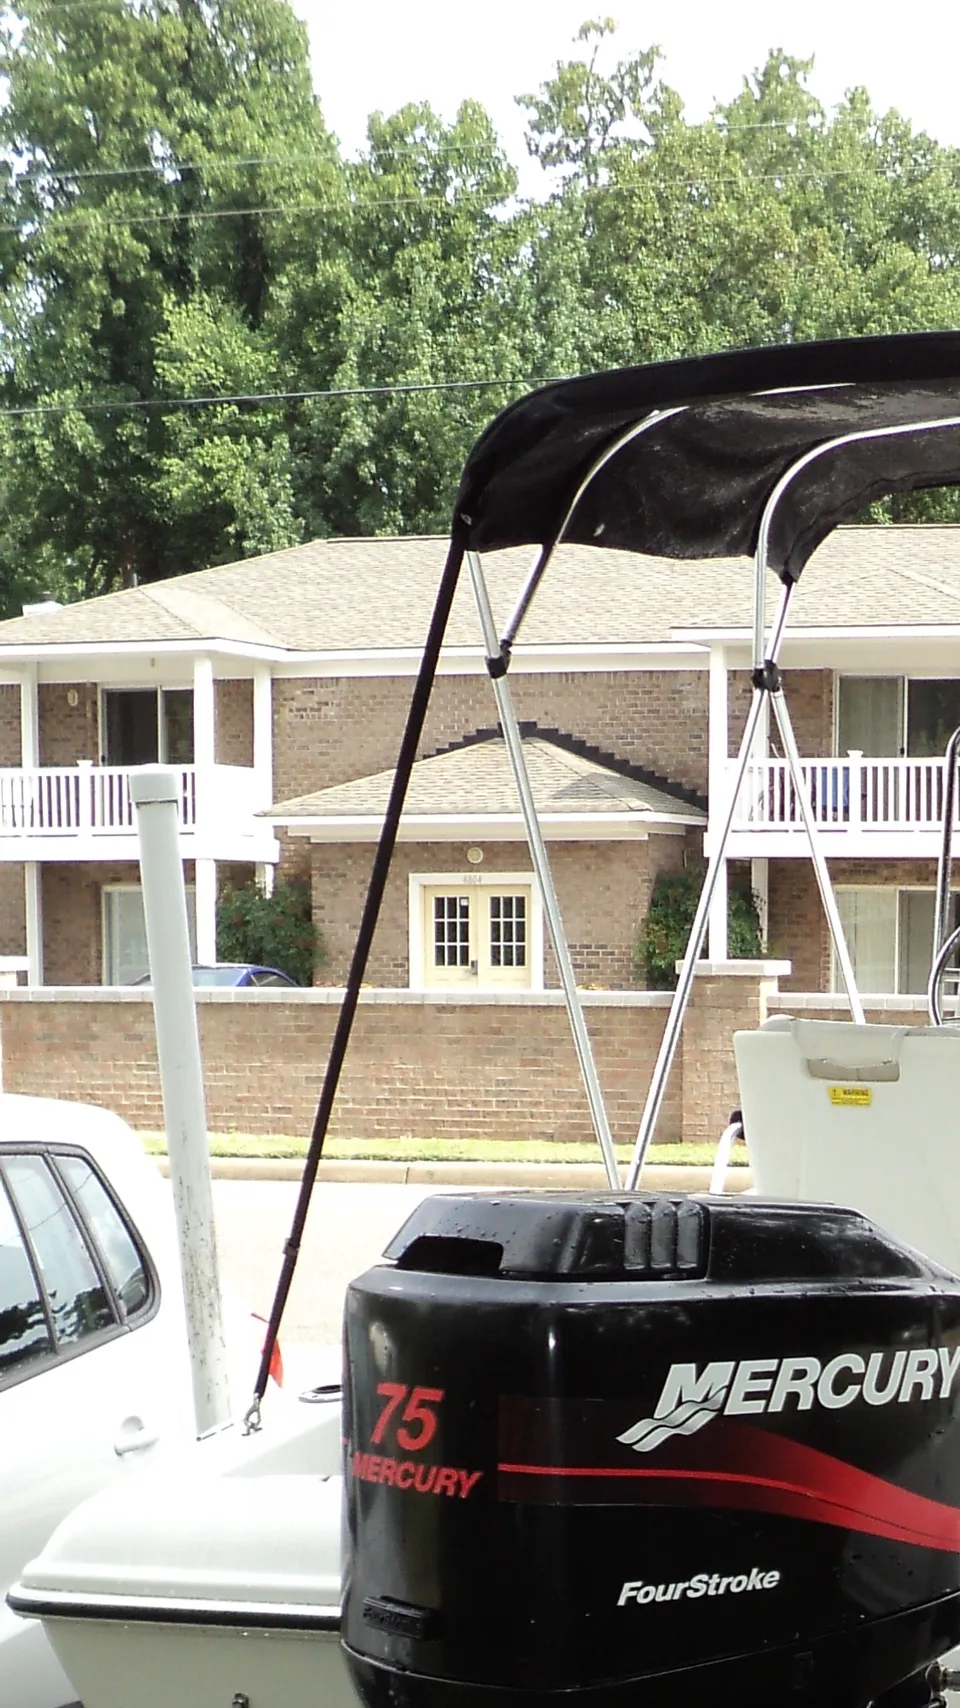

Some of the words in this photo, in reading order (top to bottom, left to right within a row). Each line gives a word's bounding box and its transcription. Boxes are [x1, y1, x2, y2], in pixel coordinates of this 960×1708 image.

[370, 1381, 445, 1451] 75
[352, 1450, 483, 1499] MERCURY
[616, 1567, 781, 1606] FourStroke
